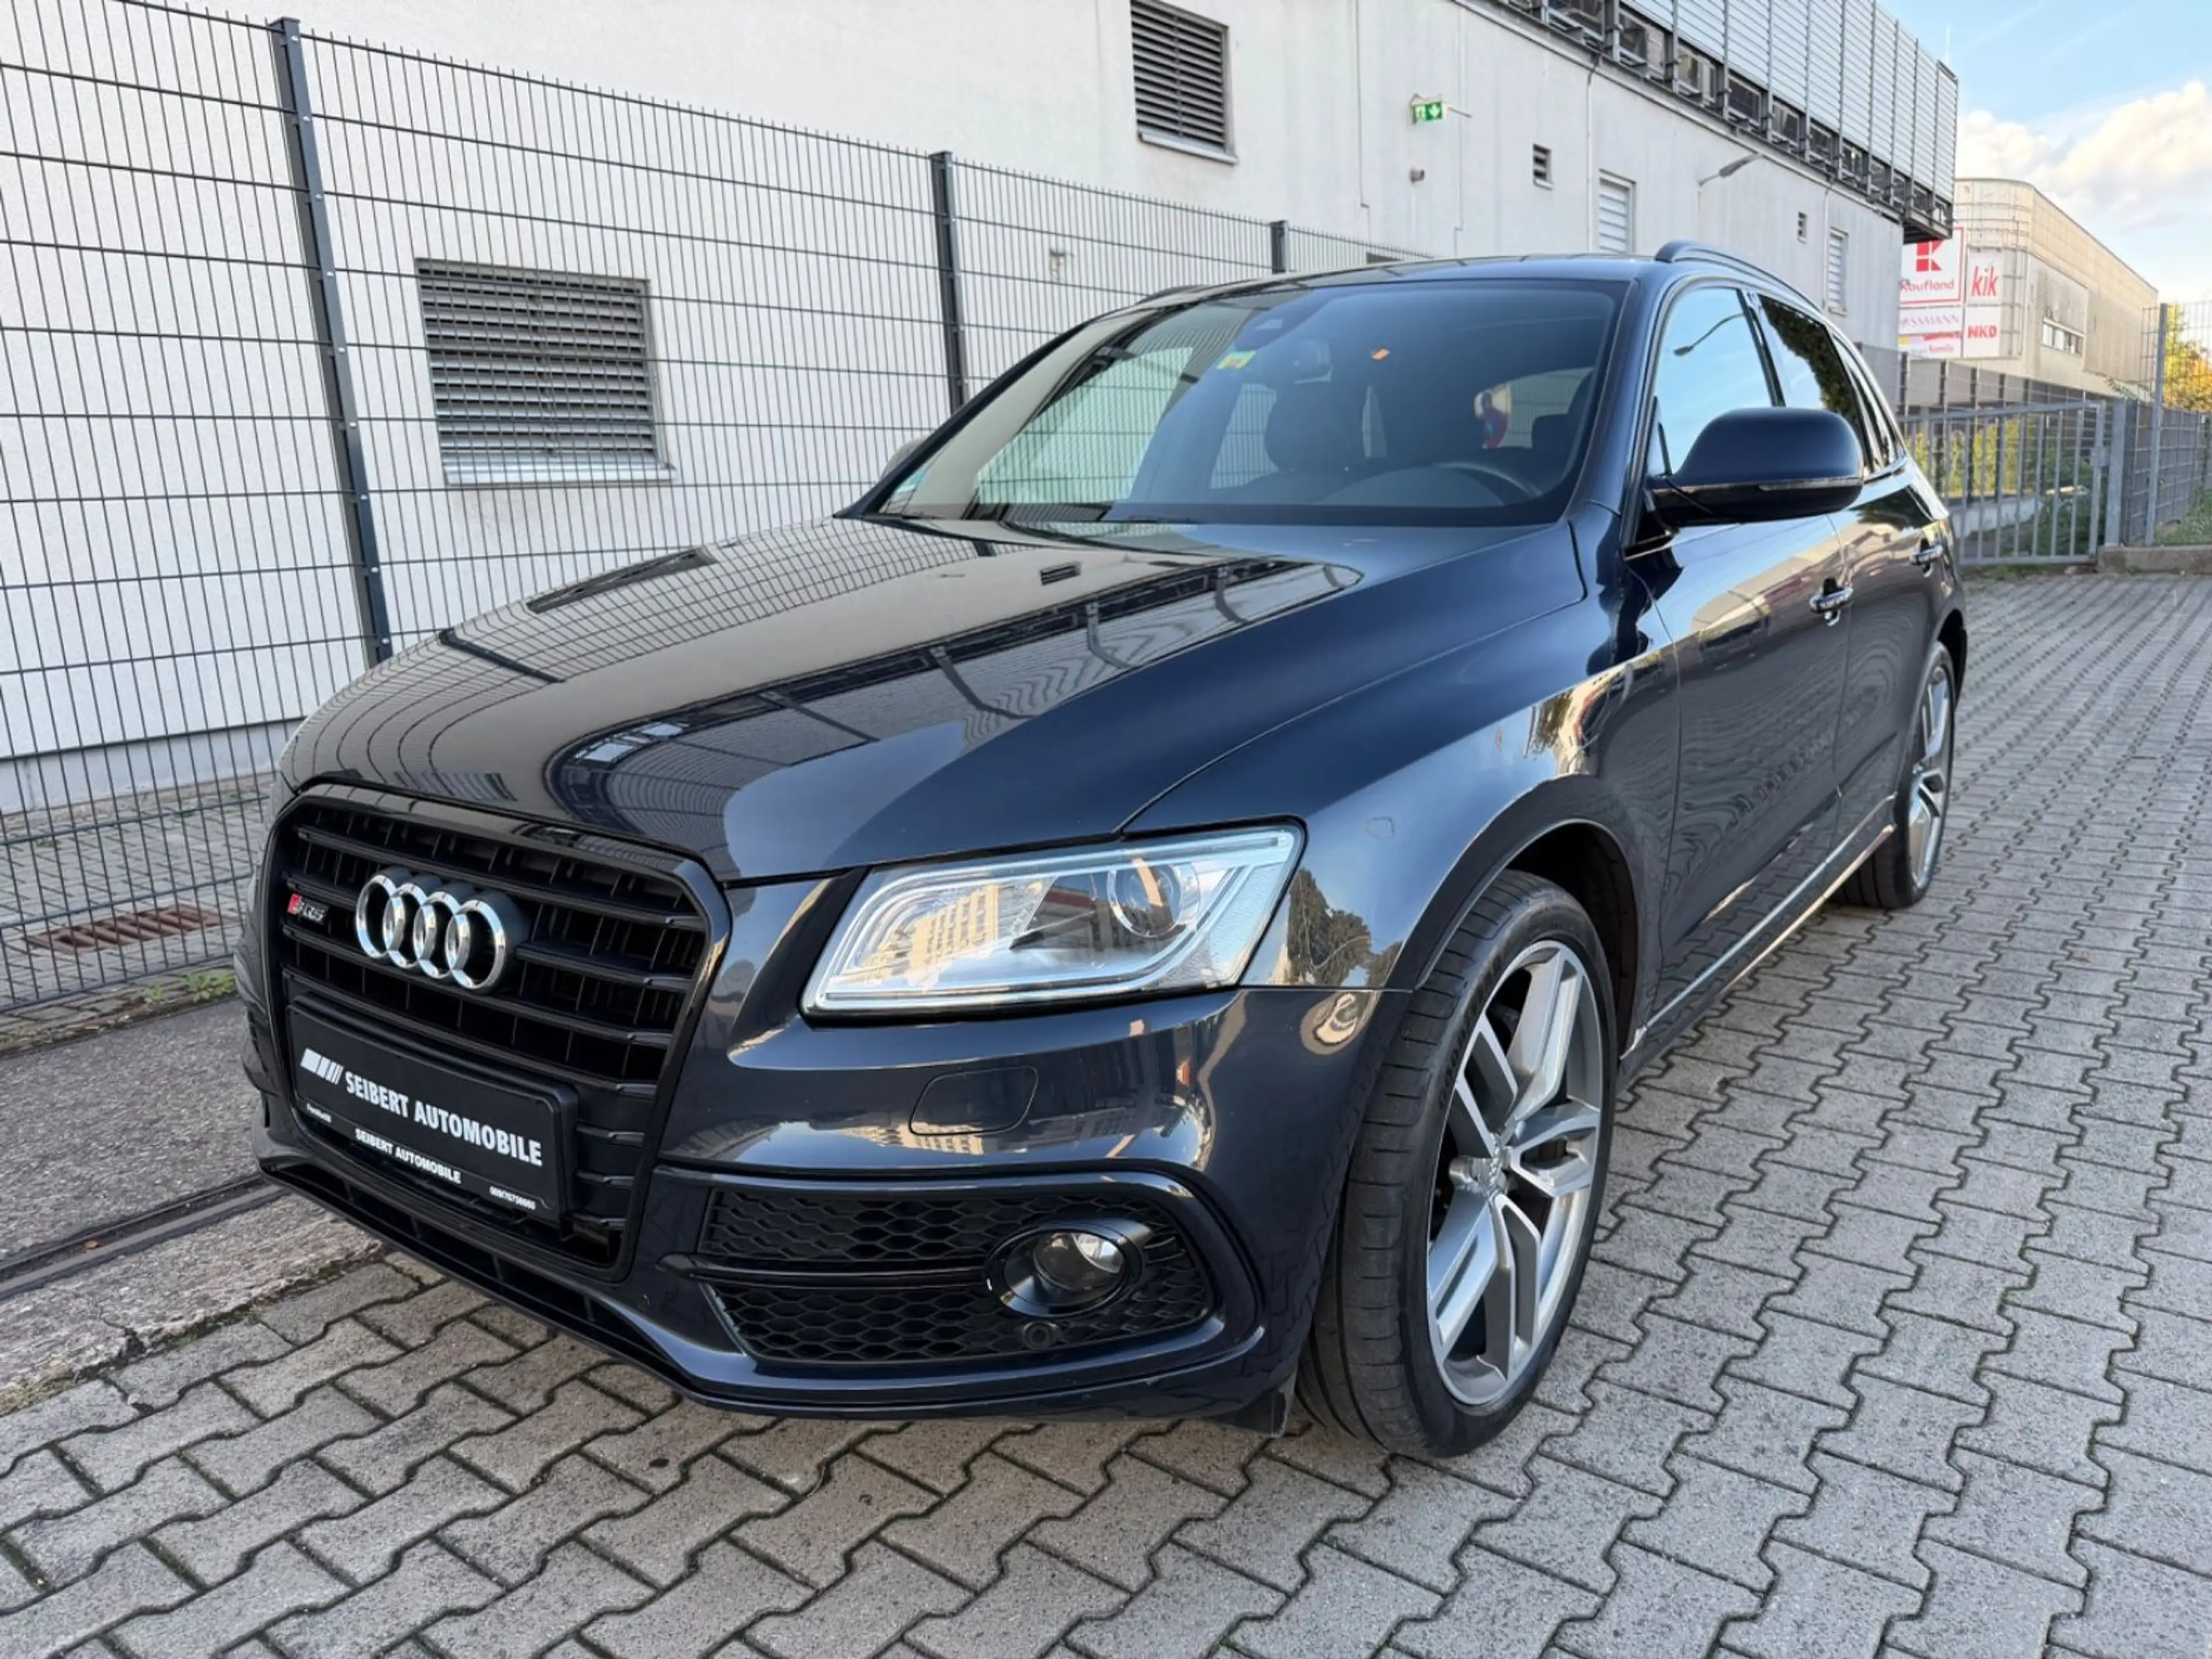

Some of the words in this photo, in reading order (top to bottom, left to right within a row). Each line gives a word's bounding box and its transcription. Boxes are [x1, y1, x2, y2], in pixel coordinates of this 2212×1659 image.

[1968, 325, 1997, 339] NKD
[346, 1071, 408, 1118] SEIBERT
[414, 1099, 543, 1166] AUTOMOBILE
[355, 1128, 393, 1157] SEIBERT
[396, 1146, 461, 1184] AUTOMOBILE
